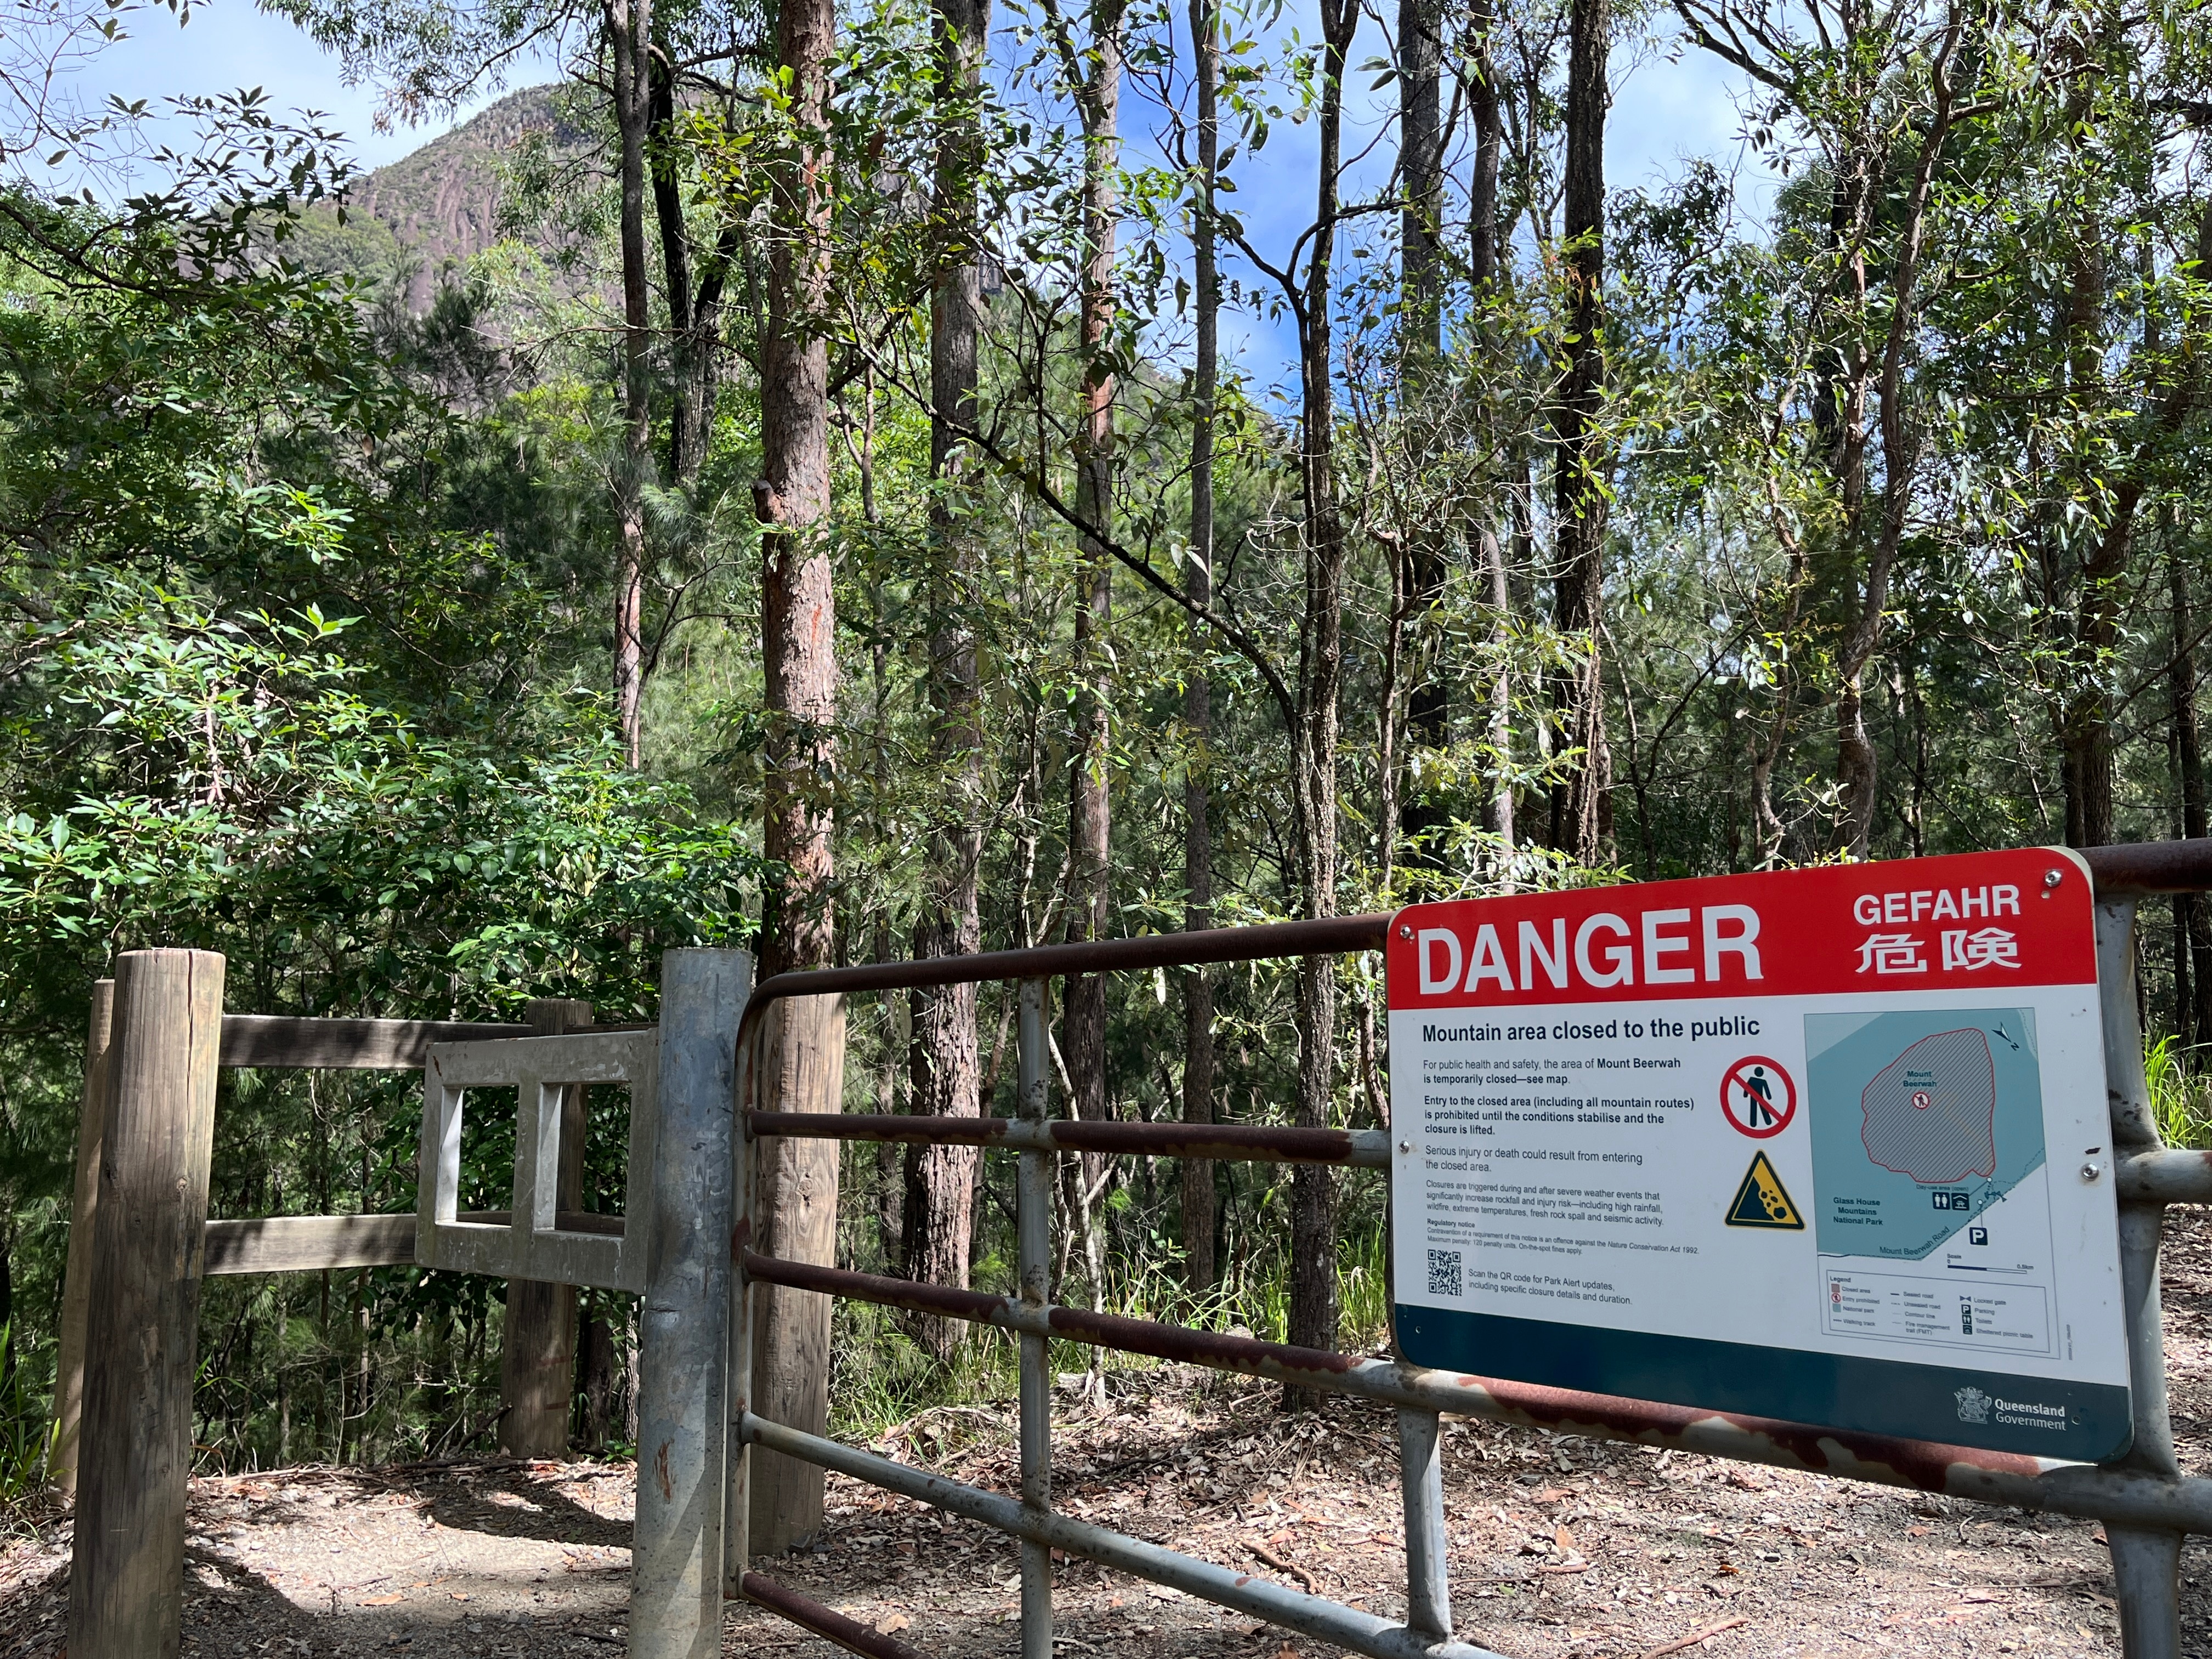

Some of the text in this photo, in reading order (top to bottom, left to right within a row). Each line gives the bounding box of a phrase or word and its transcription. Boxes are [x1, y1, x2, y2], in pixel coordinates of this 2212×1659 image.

[1853, 884, 2021, 925] GEFAHR
[1418, 904, 1764, 995] DANGER
[1854, 927, 2022, 974] 危険
[1423, 1016, 1759, 1041] Mountain area closed to the public
[1424, 1060, 1436, 1069] For
[1440, 1060, 1463, 1071] public
[1466, 1060, 1491, 1069] health
[1494, 1060, 1509, 1069] and
[1513, 1059, 1541, 1071] safety,
[1544, 1059, 1558, 1068] the
[1585, 1058, 1594, 1068] of
[1598, 1058, 1630, 1068] Mount
[1634, 1058, 1680, 1068] Beerwah
[1424, 1074, 1431, 1083] is
[1434, 1074, 1483, 1085] temporarily
[1547, 1076, 1570, 1086] map.
[1425, 1096, 1447, 1107] Entry
[1450, 1097, 1458, 1105] to
[1461, 1096, 1474, 1105] the
[1478, 1096, 1507, 1105] closed
[1534, 1097, 1583, 1109] (including
[1587, 1097, 1598, 1107] all
[1602, 1097, 1651, 1107] mountain
[1655, 1098, 1694, 1110] routes)
[1425, 1110, 1663, 1124] is prohibited until the conditions stabilise and the
[1425, 1124, 1494, 1135] closure is lifted.
[1426, 1146, 1456, 1155] Serious
[1459, 1149, 1481, 1159] injury
[1495, 1148, 1519, 1158] death
[1522, 1150, 1546, 1159] could
[1549, 1151, 1575, 1160] result
[1578, 1151, 1599, 1161] from
[1602, 1153, 1642, 1165] entering
[1426, 1160, 1438, 1169] the
[1441, 1161, 1467, 1170] closed
[1426, 1180, 1454, 1188] Closures
[1469, 1183, 1498, 1192] triggered
[1500, 1184, 1521, 1194] during
[1539, 1186, 1555, 1194] after
[1645, 1192, 1660, 1200] that
[1426, 1192, 1463, 1202] significantly
[1537, 1198, 1556, 1208] injury
[1615, 1203, 1632, 1212] high
[1634, 1204, 1662, 1214] rainfall,
[1838, 1207, 1877, 1215] Mountains
[1427, 1203, 1451, 1211] wildfire,
[1481, 1206, 1528, 1217] temperatures,
[1531, 1209, 1548, 1217] fresh
[1568, 1212, 1585, 1221] spall
[1604, 1215, 1633, 1223] seismic
[1635, 1216, 1663, 1227] activity.
[1427, 1218, 1456, 1228] Regulatory
[1880, 1226, 1950, 1255] Mount Beerwah Road
[1468, 1268, 1485, 1277] Scan
[1500, 1272, 1511, 1280] QR
[1533, 1275, 1542, 1283] for
[1545, 1276, 1561, 1285] Park
[1563, 1278, 1580, 1287] Alert
[1582, 1280, 1614, 1291] updates,
[1468, 1282, 1498, 1293] including
[1528, 1287, 1554, 1296] closure
[1556, 1290, 1580, 1299] details
[1599, 1294, 1632, 1304] duration.
[1995, 1399, 2065, 1417] Queensland
[1996, 1412, 2067, 1431] Government
